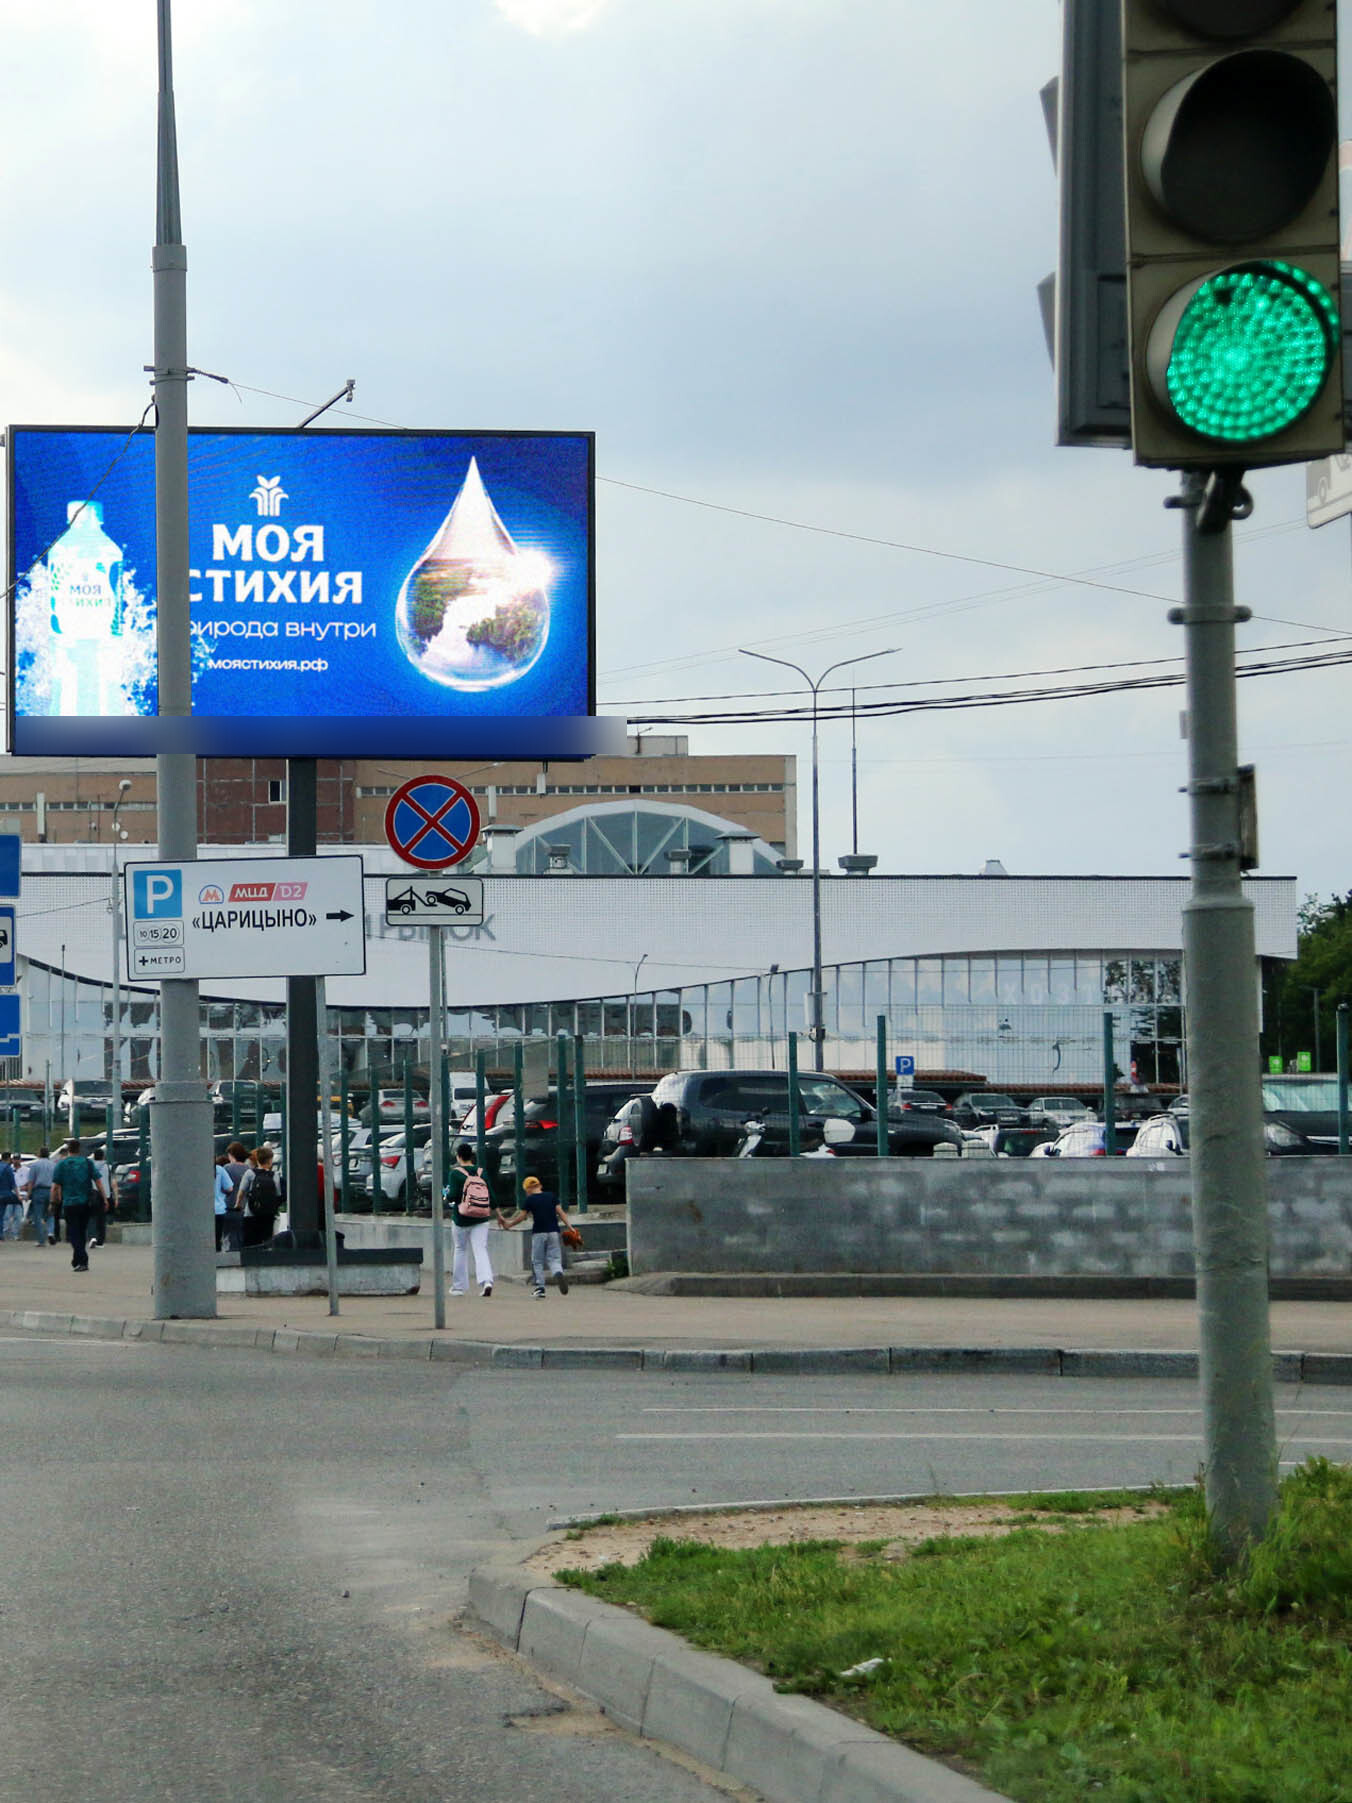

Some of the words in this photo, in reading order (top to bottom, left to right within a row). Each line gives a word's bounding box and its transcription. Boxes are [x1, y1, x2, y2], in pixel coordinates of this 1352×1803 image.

[212, 524, 325, 562] МОЯ
[190, 621, 279, 640] ирода
[285, 621, 377, 641] внутри
[208, 658, 329, 673] моястихия.рф
[146, 875, 174, 914] P
[279, 885, 303, 898] D2
[192, 908, 317, 933] «ЦАРИЦЫНО»
[150, 929, 160, 939] 15
[162, 927, 178, 939] 20
[900, 1057, 911, 1073] P
